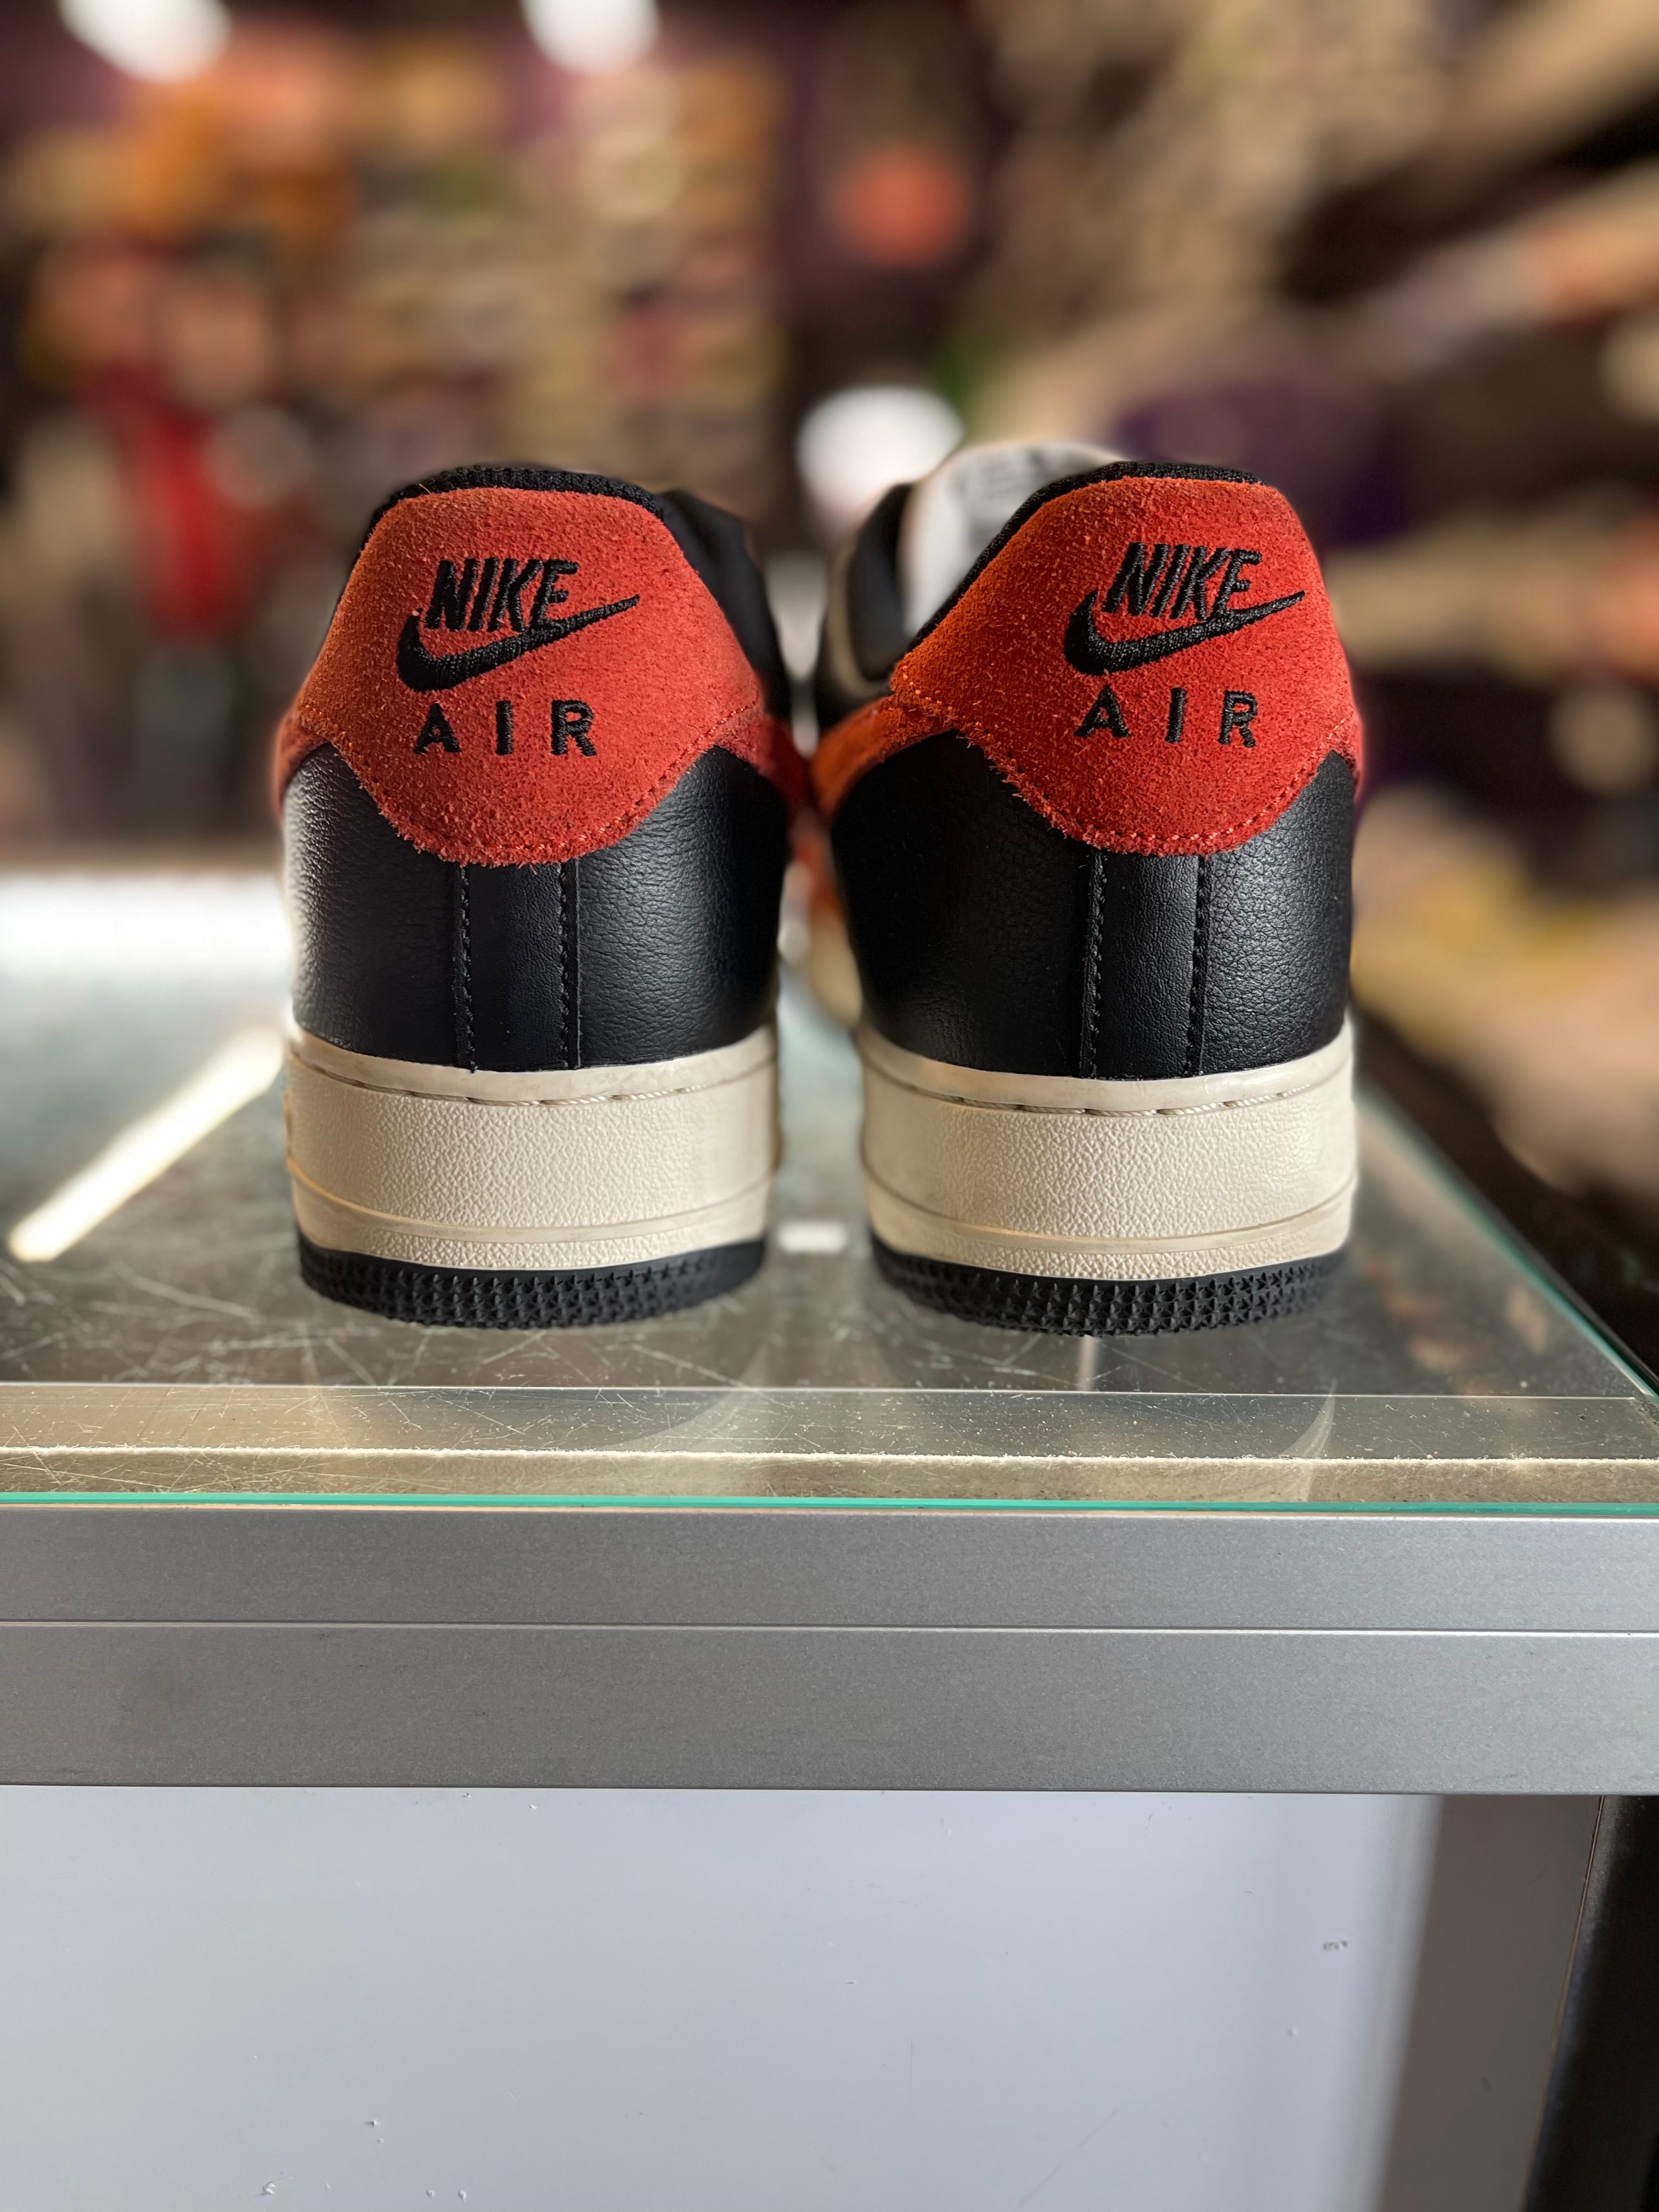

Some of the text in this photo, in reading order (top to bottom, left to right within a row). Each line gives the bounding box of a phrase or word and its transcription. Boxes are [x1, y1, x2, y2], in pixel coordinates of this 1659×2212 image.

[425, 557, 579, 632] NIKE
[1102, 542, 1262, 620] NIKE
[413, 699, 596, 756] AIR
[1074, 685, 1258, 748] AIR
